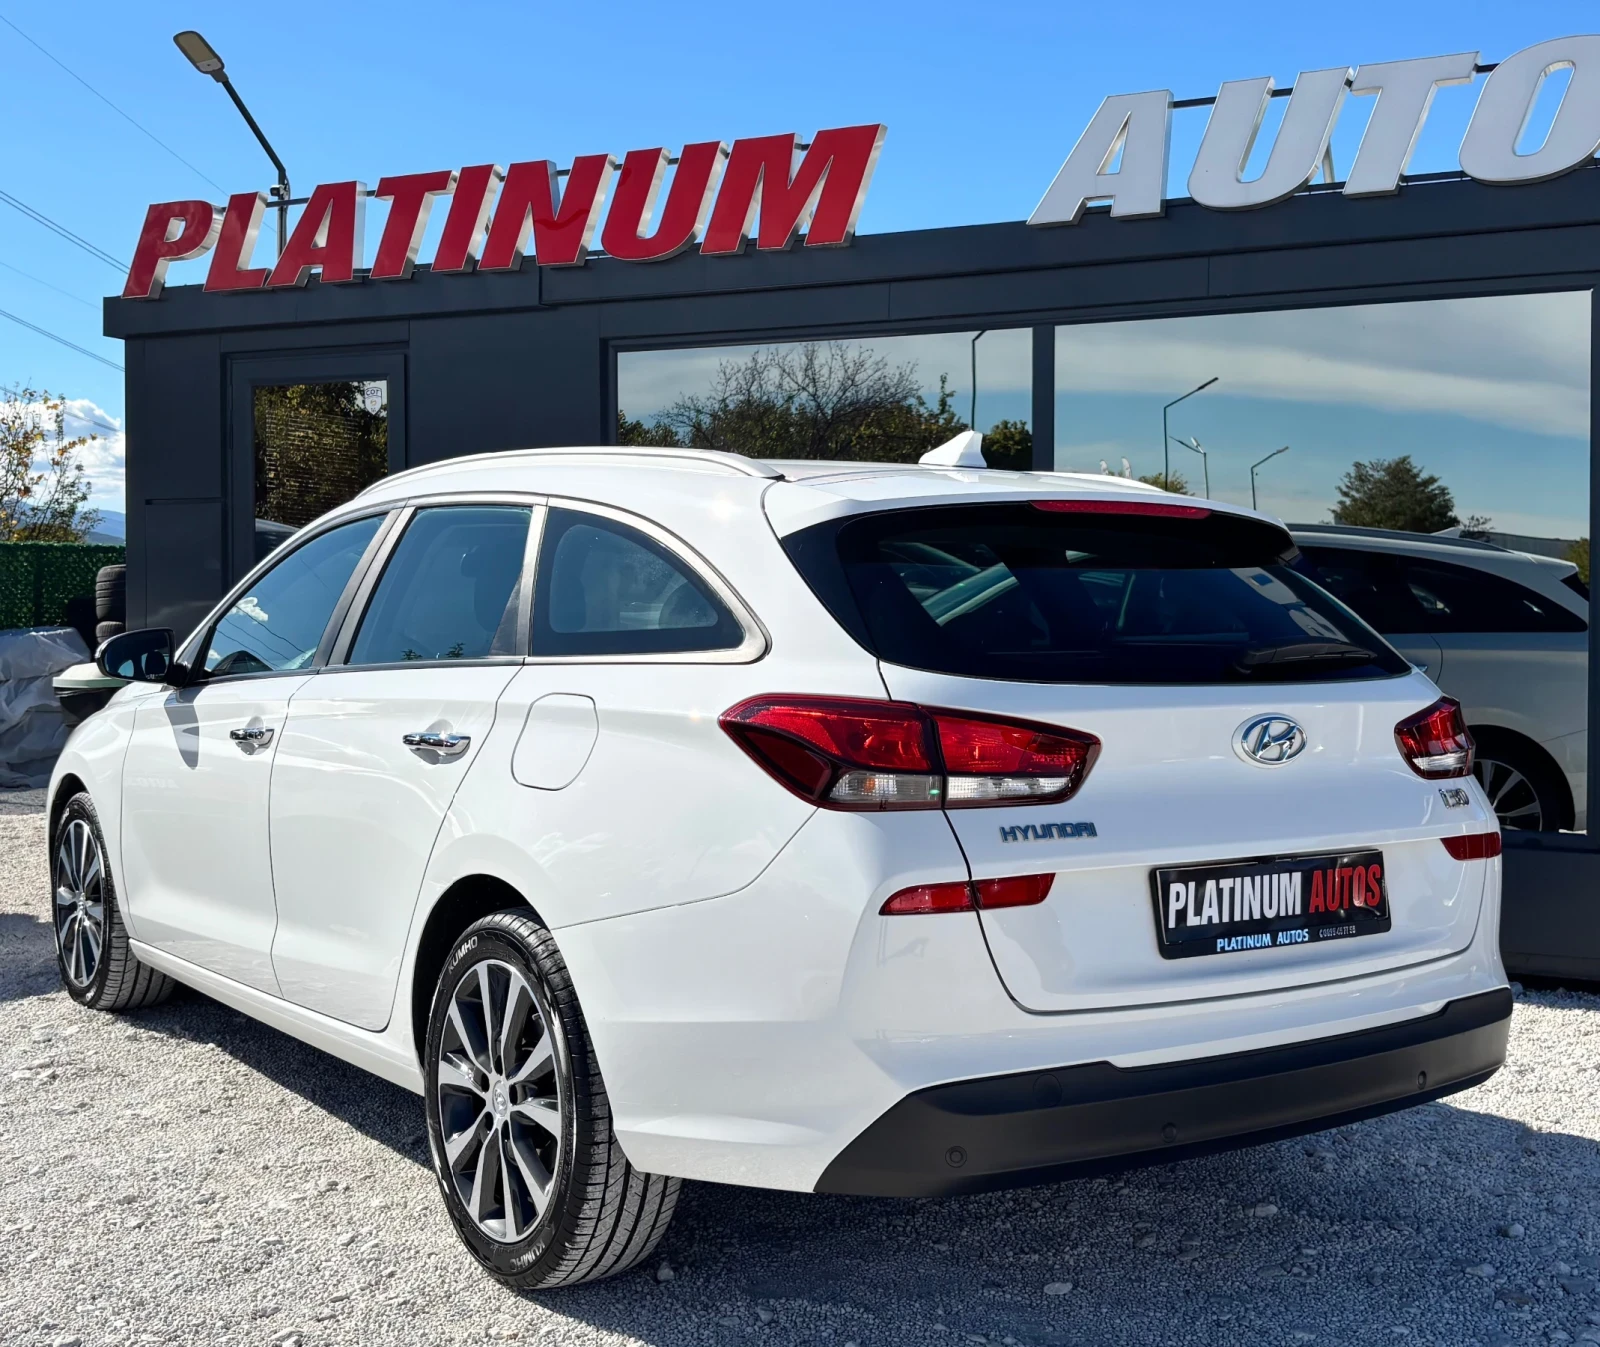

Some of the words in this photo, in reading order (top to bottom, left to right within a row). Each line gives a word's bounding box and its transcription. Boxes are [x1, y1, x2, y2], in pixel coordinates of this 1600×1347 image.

[121, 123, 887, 300] PLATINUM
[1026, 34, 1600, 228] AUTO
[999, 822, 1098, 843] HYUNDAI
[1168, 872, 1302, 928] PLATINUM
[1309, 865, 1380, 913] AUTOS
[447, 935, 478, 975] KUMHO
[1217, 933, 1271, 952] PLATINUM
[1276, 929, 1309, 944] AUTOS
